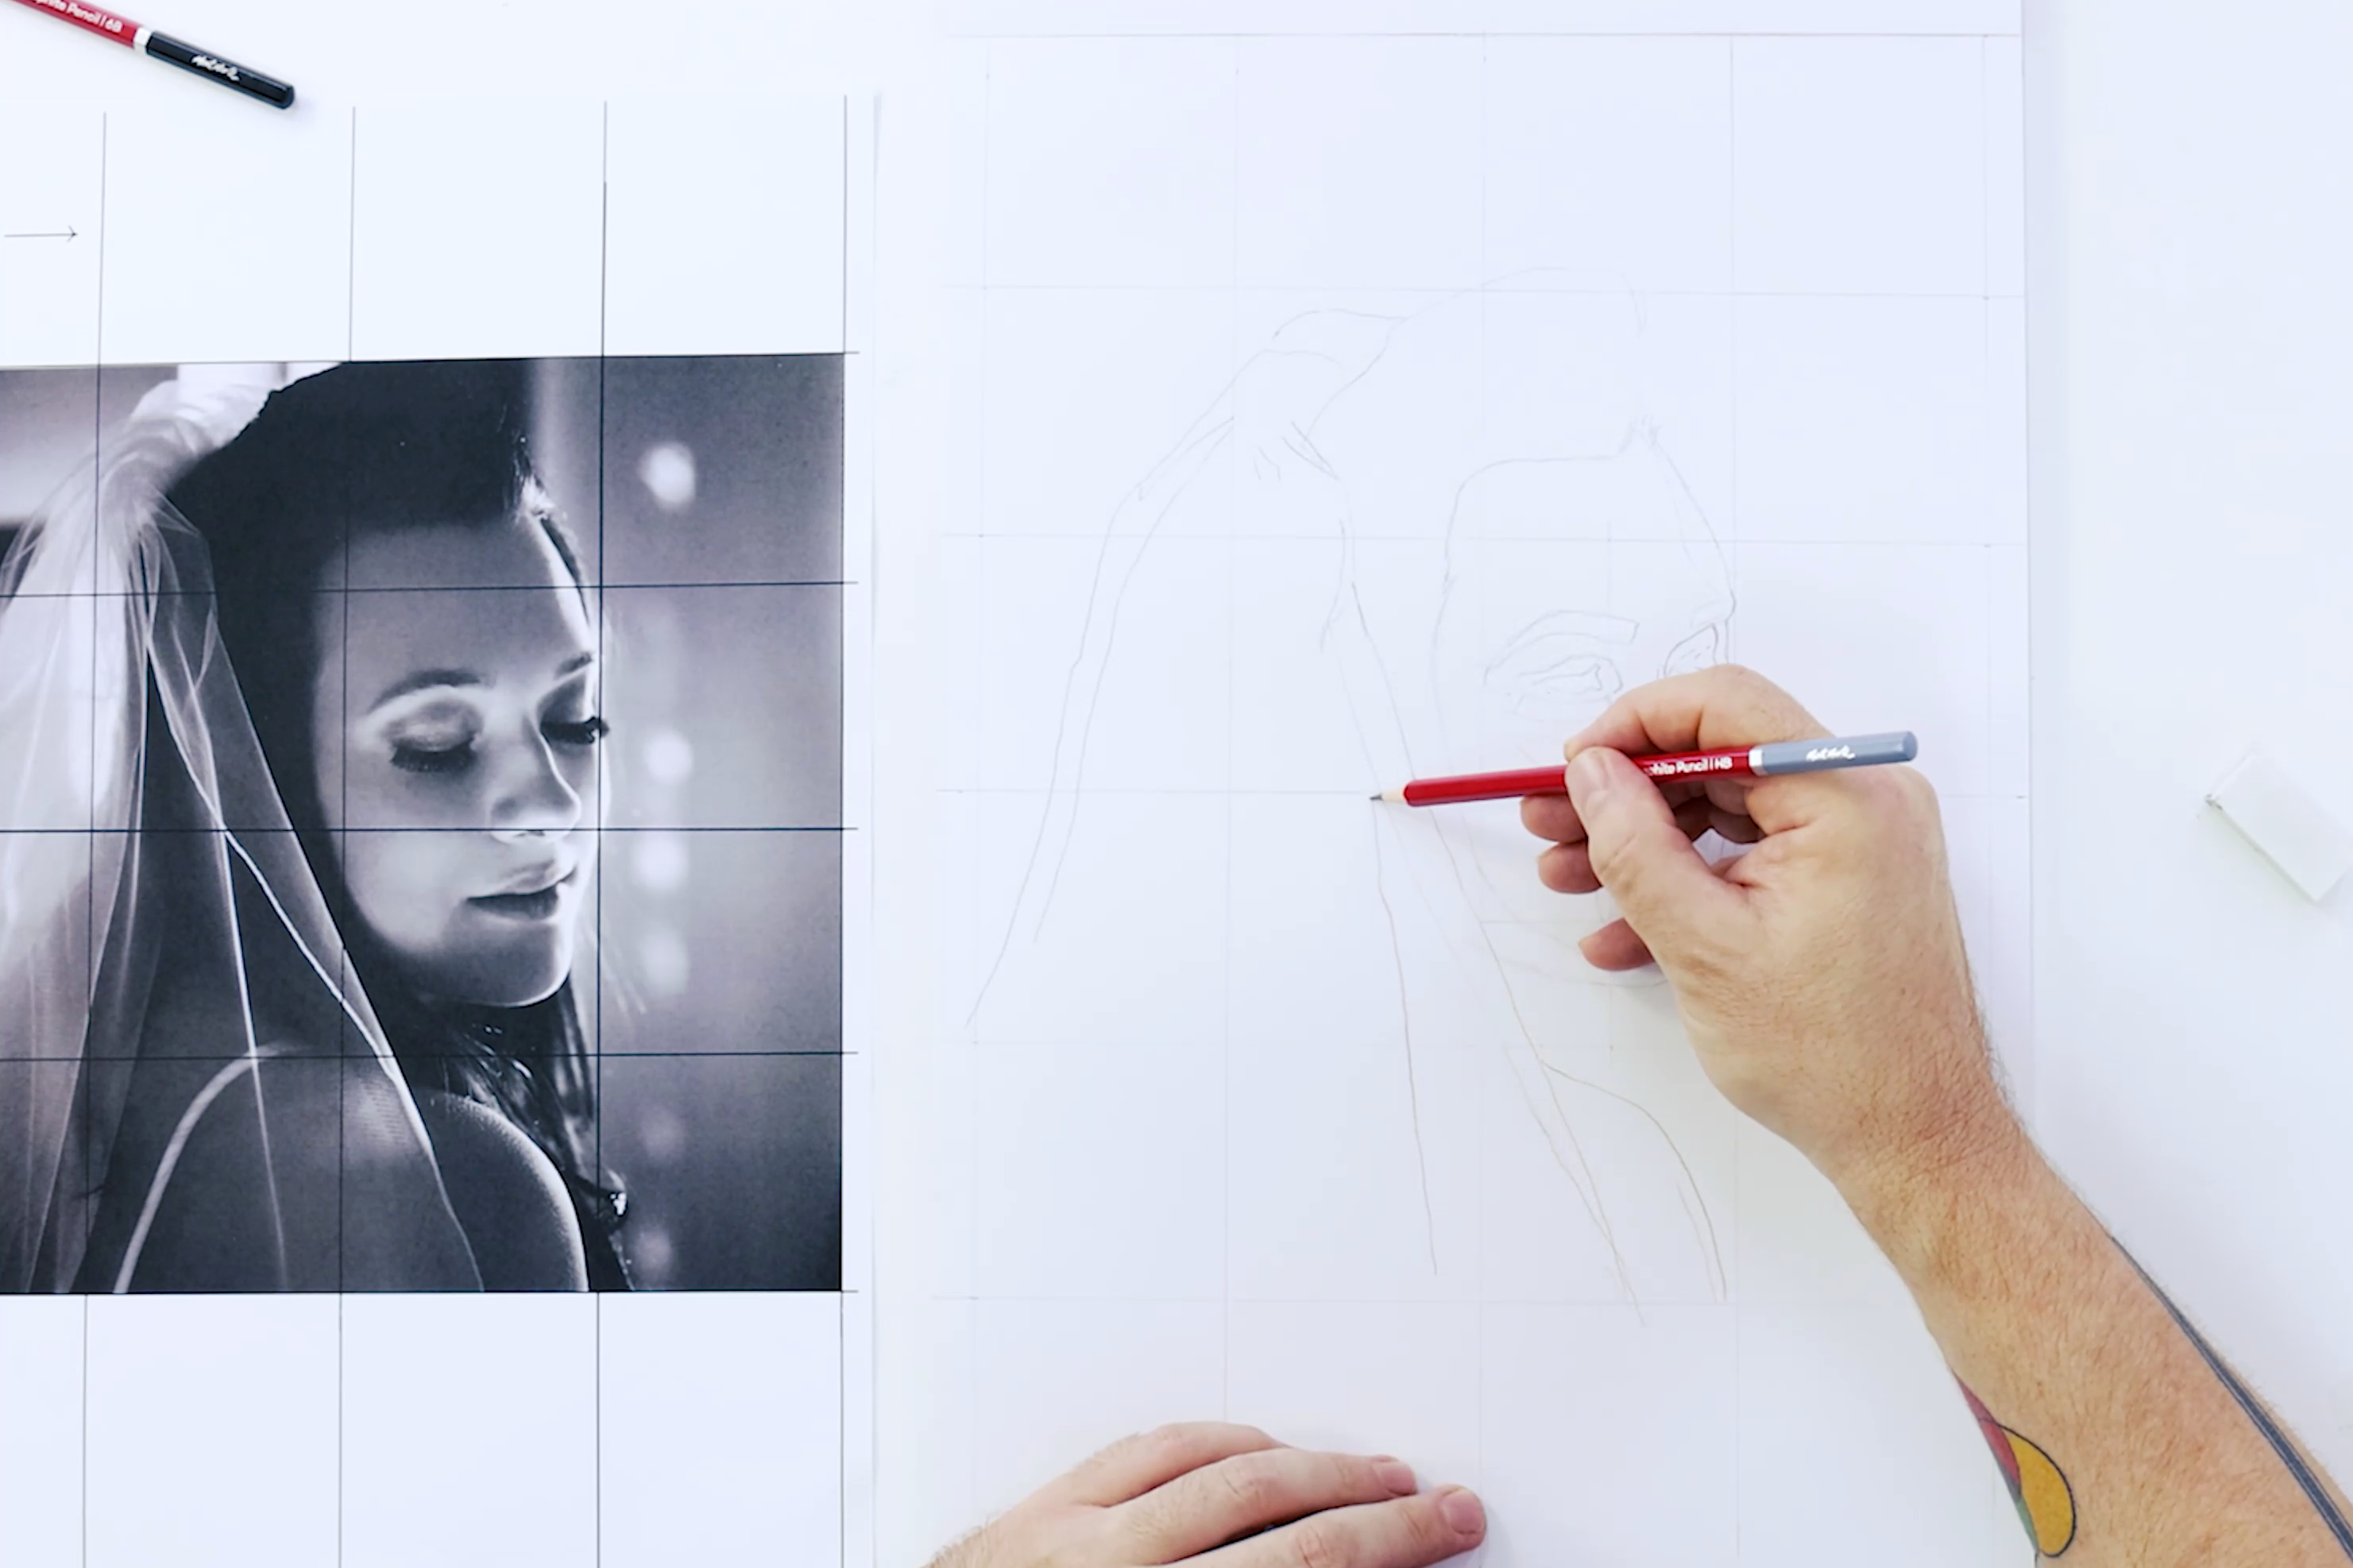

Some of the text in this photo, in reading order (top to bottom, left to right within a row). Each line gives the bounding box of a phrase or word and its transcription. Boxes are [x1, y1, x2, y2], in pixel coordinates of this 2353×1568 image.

[66, 2, 102, 25] Pencil
[105, 18, 123, 33] 6B
[1676, 757, 1709, 774] Pencil
[1714, 756, 1733, 770] HB
